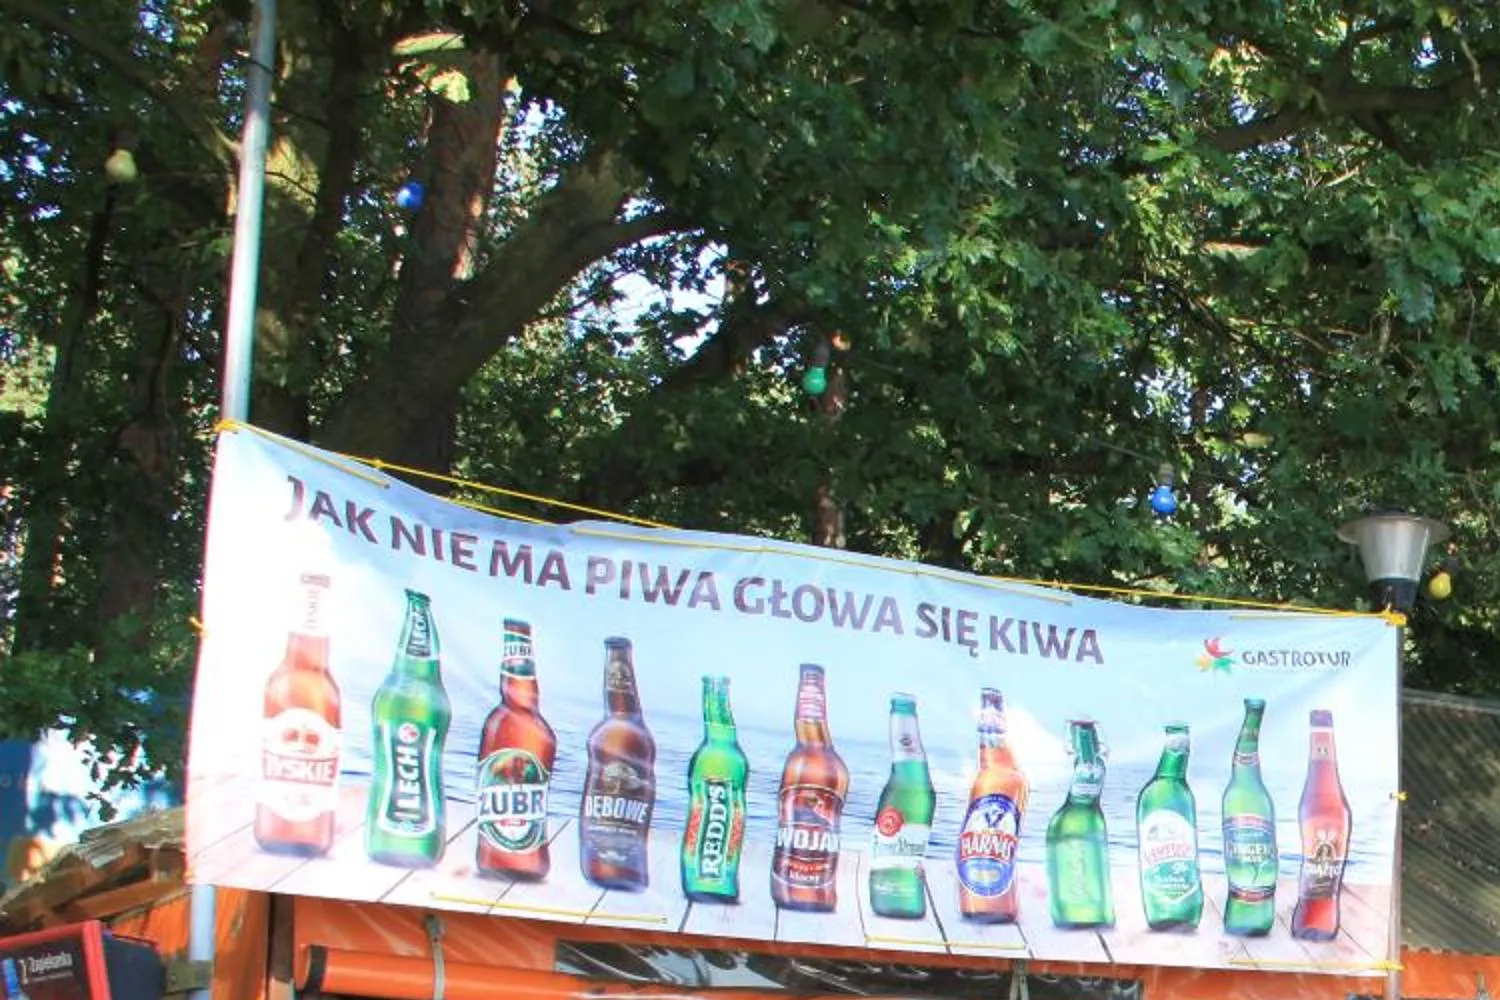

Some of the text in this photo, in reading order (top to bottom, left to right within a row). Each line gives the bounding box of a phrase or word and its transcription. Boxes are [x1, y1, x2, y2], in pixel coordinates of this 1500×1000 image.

[284, 475, 1104, 665] JAK NIE MA PIWA GŁOWA SIĘ KIWA
[1242, 650, 1351, 668] GASTROTUR
[397, 744, 421, 809] LECH
